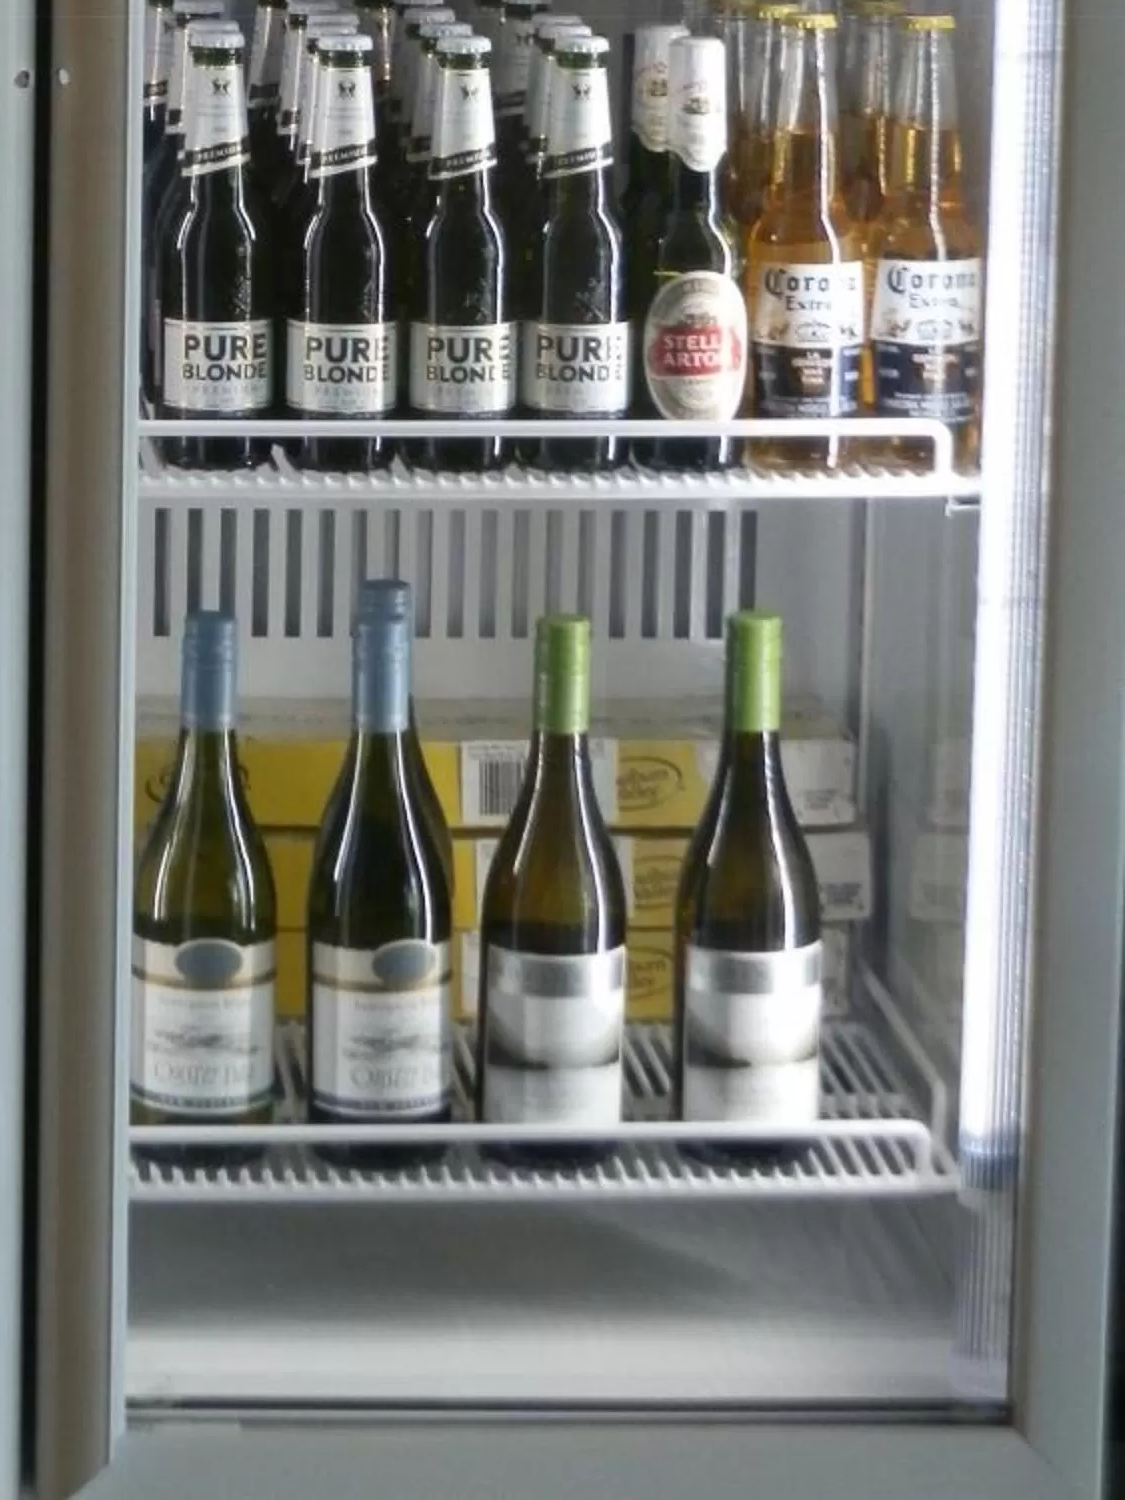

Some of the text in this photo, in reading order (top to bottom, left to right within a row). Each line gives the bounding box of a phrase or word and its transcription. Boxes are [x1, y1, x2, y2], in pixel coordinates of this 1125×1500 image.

[764, 267, 857, 300] Coroa
[183, 333, 267, 362] PURE
[305, 336, 389, 363] PURE
[427, 336, 511, 364] PURE
[663, 334, 723, 351] STELL
[182, 363, 268, 382] BLONDE
[303, 364, 389, 384] BLONDE
